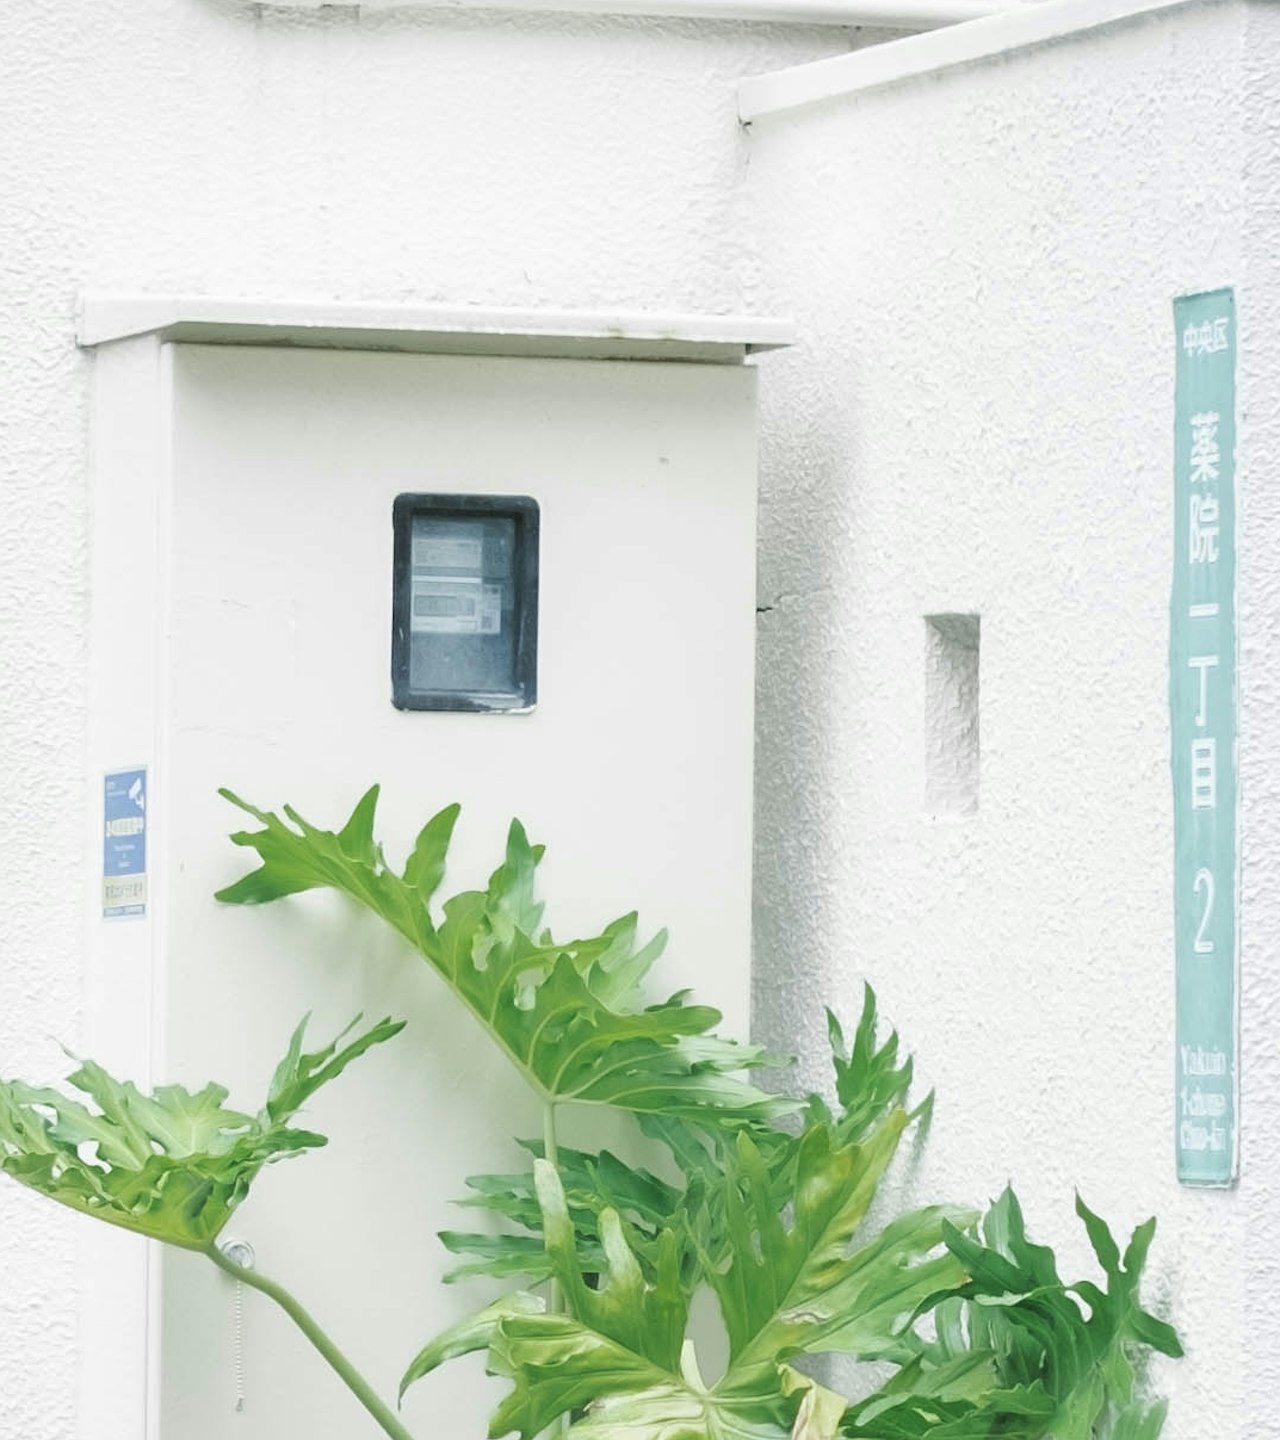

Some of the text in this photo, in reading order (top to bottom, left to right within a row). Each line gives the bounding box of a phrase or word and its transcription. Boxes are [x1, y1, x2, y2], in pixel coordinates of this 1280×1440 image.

[1182, 318, 1228, 357] 中央区
[1192, 868, 1216, 953] 2
